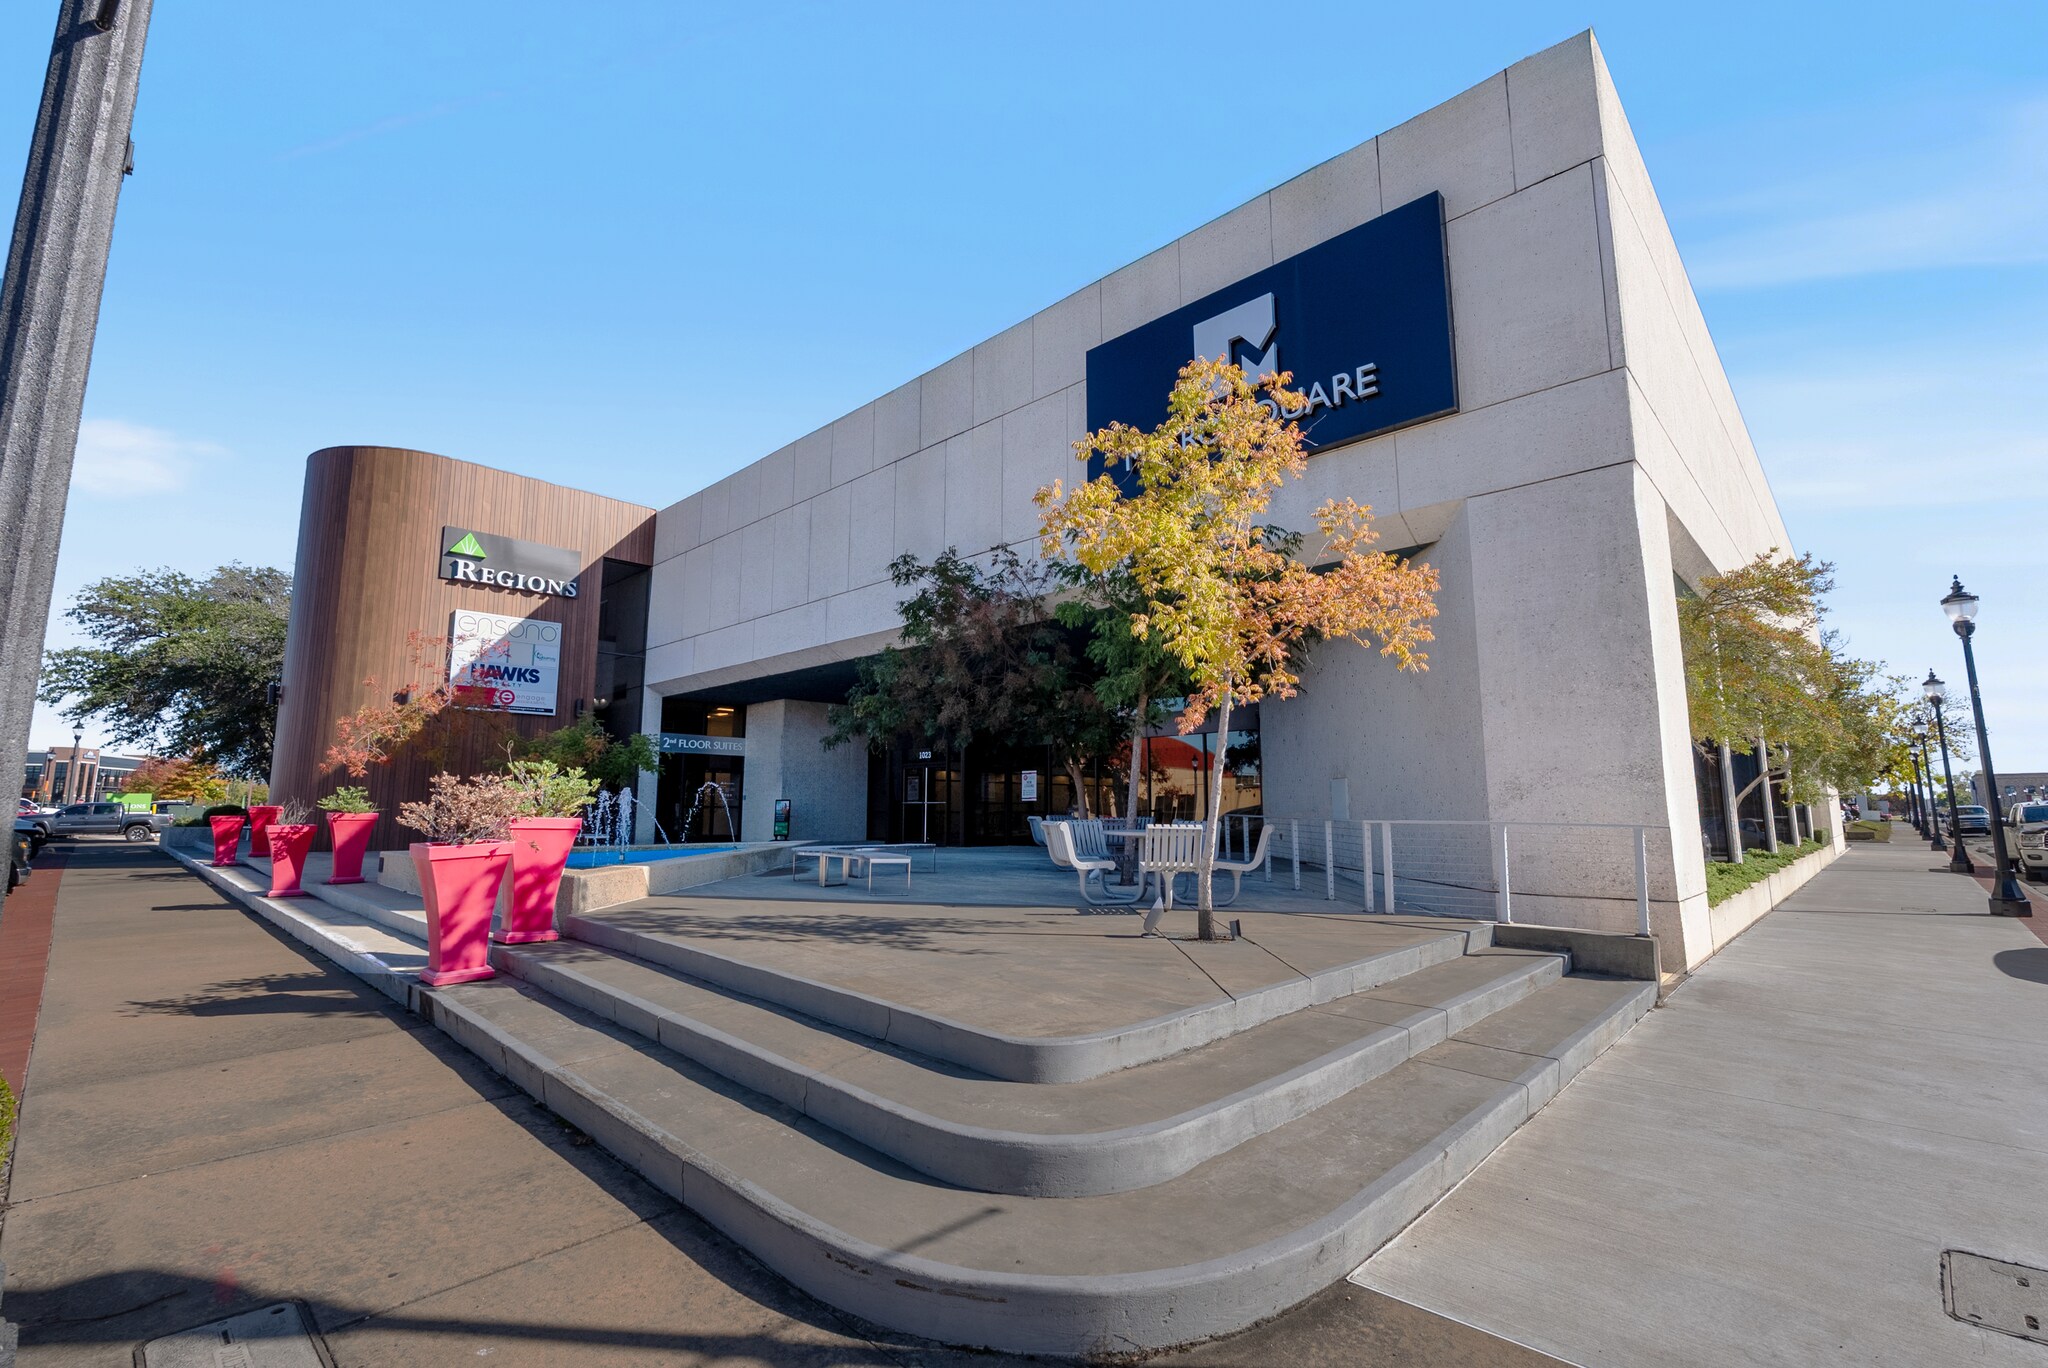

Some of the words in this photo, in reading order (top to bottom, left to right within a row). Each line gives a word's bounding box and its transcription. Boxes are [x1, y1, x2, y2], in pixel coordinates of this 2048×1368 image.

[1252, 362, 1380, 422] QUARE
[454, 558, 577, 598] REGIONS
[458, 614, 557, 642] ensono
[471, 663, 541, 684] HAWKS
[663, 736, 677, 748] 2nd
[678, 739, 711, 749] FLOOR
[714, 741, 743, 751] SUITES
[919, 751, 932, 759] 1023
